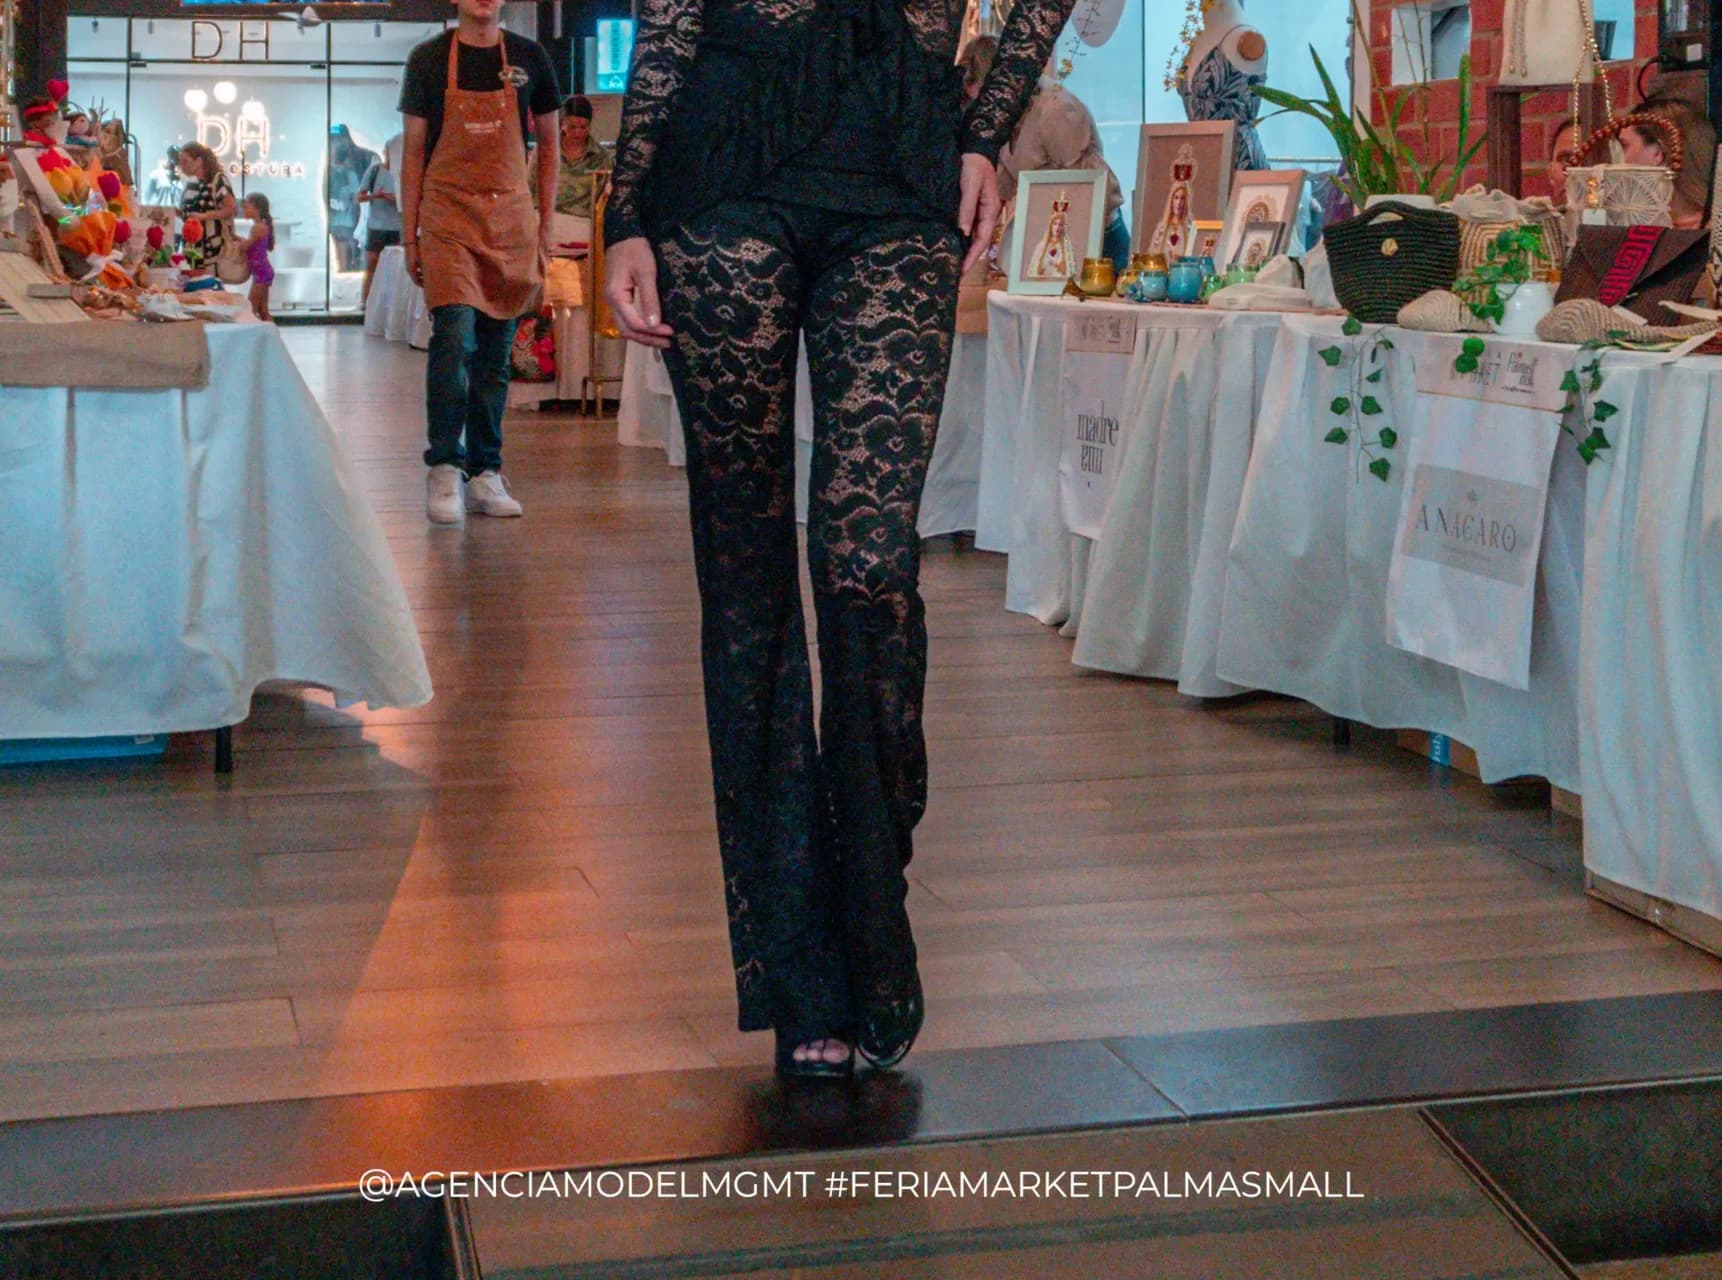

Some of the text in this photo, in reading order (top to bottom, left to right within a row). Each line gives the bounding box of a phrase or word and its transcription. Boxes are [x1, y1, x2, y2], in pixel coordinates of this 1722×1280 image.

[191, 20, 269, 60] DH
[197, 113, 271, 158] DH
[222, 162, 305, 177] OSTURA
[1077, 399, 1119, 447] madre
